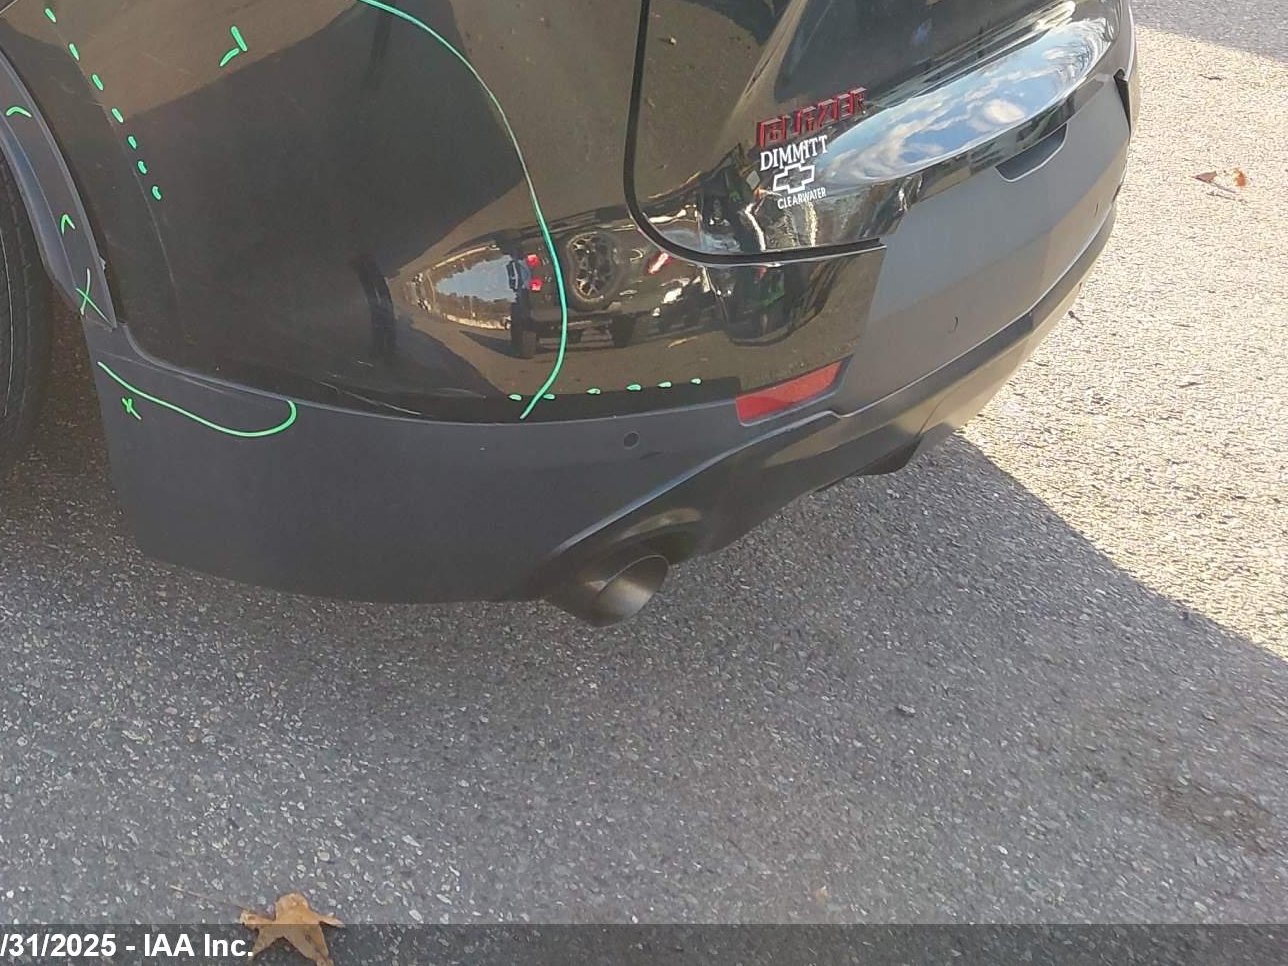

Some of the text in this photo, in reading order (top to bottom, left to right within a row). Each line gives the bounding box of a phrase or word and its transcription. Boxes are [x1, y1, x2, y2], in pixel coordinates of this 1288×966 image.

[756, 86, 868, 149] BLAZER
[759, 134, 829, 172] DIMMITT
[777, 186, 827, 210] CLEARWATER
